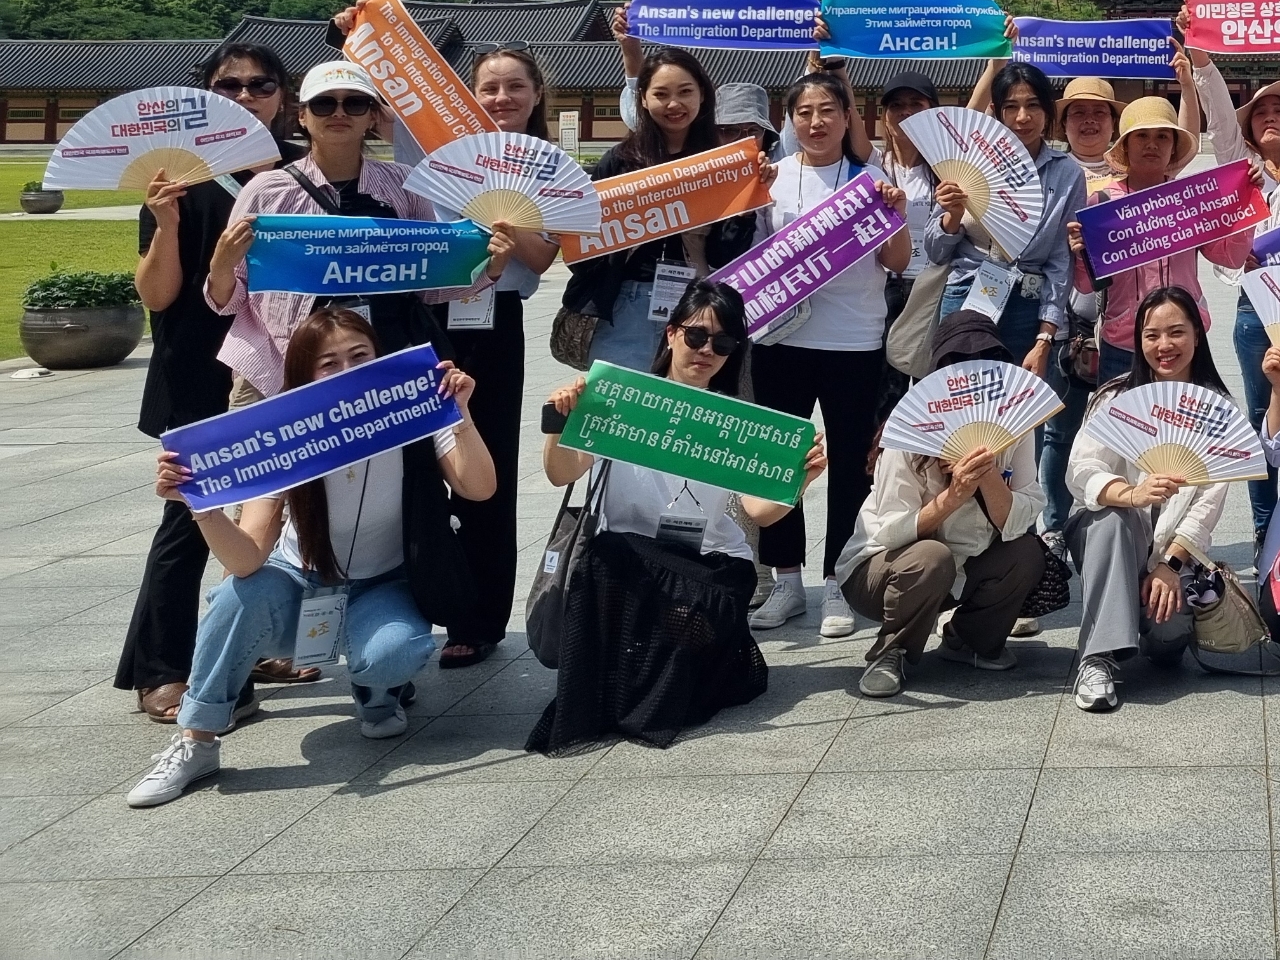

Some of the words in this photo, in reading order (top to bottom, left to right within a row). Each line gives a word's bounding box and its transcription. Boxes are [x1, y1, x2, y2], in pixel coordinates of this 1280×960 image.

[637, 5, 699, 20] Ansan's
[702, 9, 734, 20] new
[825, 5, 887, 18] Управление
[889, 4, 963, 16] миграционной
[865, 18, 893, 29] Этим
[894, 17, 942, 29] займётся
[943, 18, 972, 29] город
[1196, 2, 1256, 19] 이민청은
[379, 1, 398, 25] The
[394, 21, 447, 86] Immigration
[637, 23, 660, 36] The
[663, 23, 738, 40] Immigration
[879, 32, 957, 52] Ансан!
[1067, 37, 1096, 49] new
[1099, 35, 1170, 52] challenge!
[346, 22, 423, 117] Ansan
[1012, 51, 1031, 63] The
[1034, 51, 1099, 66] Immigration
[1102, 53, 1169, 67] Department!
[380, 32, 394, 47] to
[389, 43, 408, 64] the
[403, 62, 458, 125] Intercultural
[110, 118, 181, 138] 대한민국의
[137, 99, 179, 117] 안산의
[181, 97, 209, 130] 길
[475, 153, 534, 179] 대한민국의
[504, 140, 538, 161] 안산의
[536, 151, 561, 181] 길
[970, 130, 1007, 176] 대한민국의
[599, 171, 672, 201] mmigration
[673, 149, 748, 180] Department
[612, 198, 635, 212] the
[637, 172, 713, 206] Intercultural
[715, 166, 739, 185] City
[742, 162, 755, 177] of
[1115, 204, 1141, 222] Văn
[1141, 194, 1183, 214] phòng
[1183, 184, 1195, 199] di
[1195, 178, 1218, 195] trú!
[1108, 228, 1134, 243] Con
[1135, 216, 1176, 236] đường
[1176, 205, 1199, 222] của
[1200, 191, 1240, 214] Ansan!
[304, 243, 342, 255] Этим
[344, 241, 409, 254] займётся
[411, 241, 449, 254] город
[338, 226, 439, 240] миграционной
[1102, 249, 1128, 265] Con
[1129, 235, 1171, 257] đường
[1171, 227, 1194, 244] của
[1195, 218, 1220, 235] Hàn
[1220, 203, 1256, 227] Quốc!
[322, 258, 428, 285] Ансан!
[946, 372, 981, 391] 안산의
[982, 366, 1006, 402] 길
[927, 391, 985, 414] 대한민국의
[1179, 392, 1211, 416] 안산의
[1207, 406, 1232, 439] 길
[190, 429, 277, 474] Ansan's
[279, 412, 326, 442] new
[329, 369, 437, 423] challenge!
[1151, 404, 1204, 434] 대한민국의
[196, 474, 232, 497] The
[237, 436, 341, 483] Immigration
[344, 394, 442, 443] Department!
